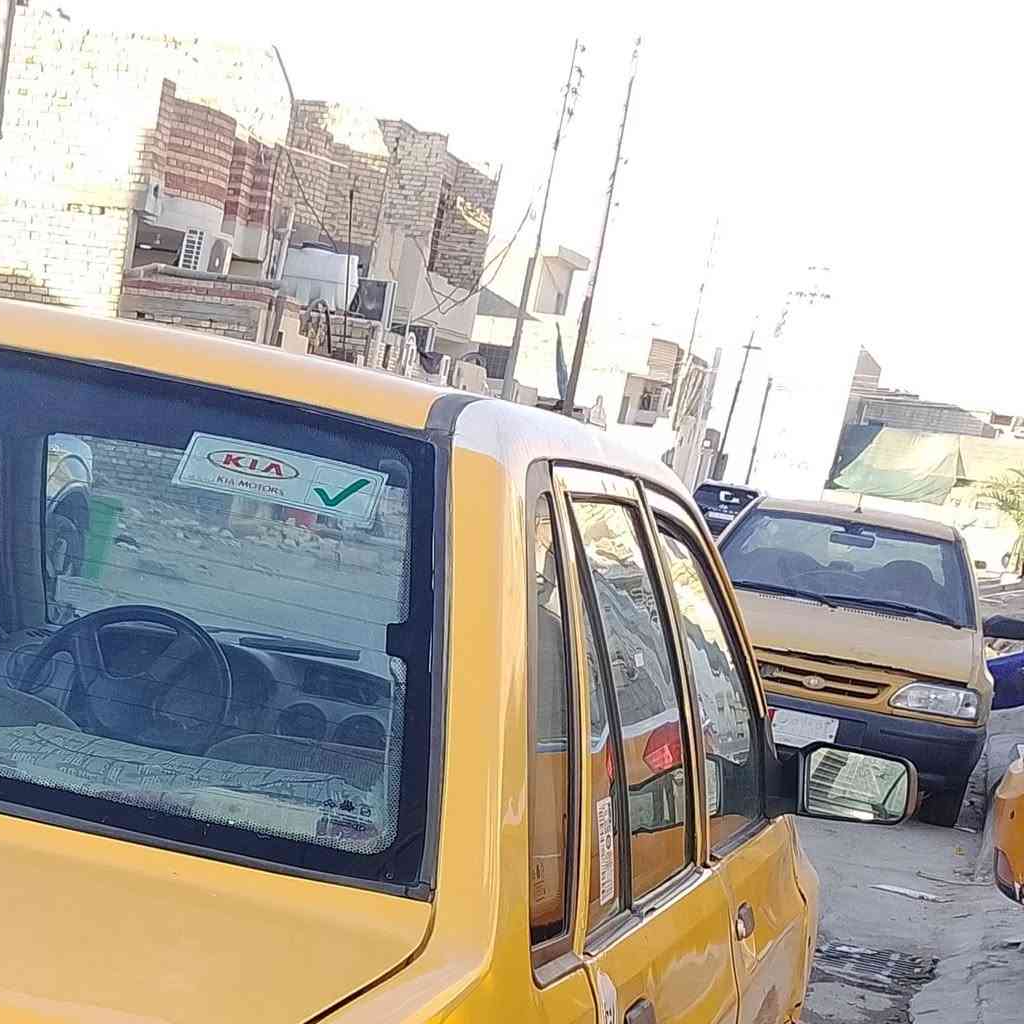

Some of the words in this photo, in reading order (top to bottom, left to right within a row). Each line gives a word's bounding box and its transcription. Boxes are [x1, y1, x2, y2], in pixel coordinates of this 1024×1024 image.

[222, 453, 283, 477] KIA
[216, 475, 236, 487] KIA
[238, 479, 285, 497] MOTORS
